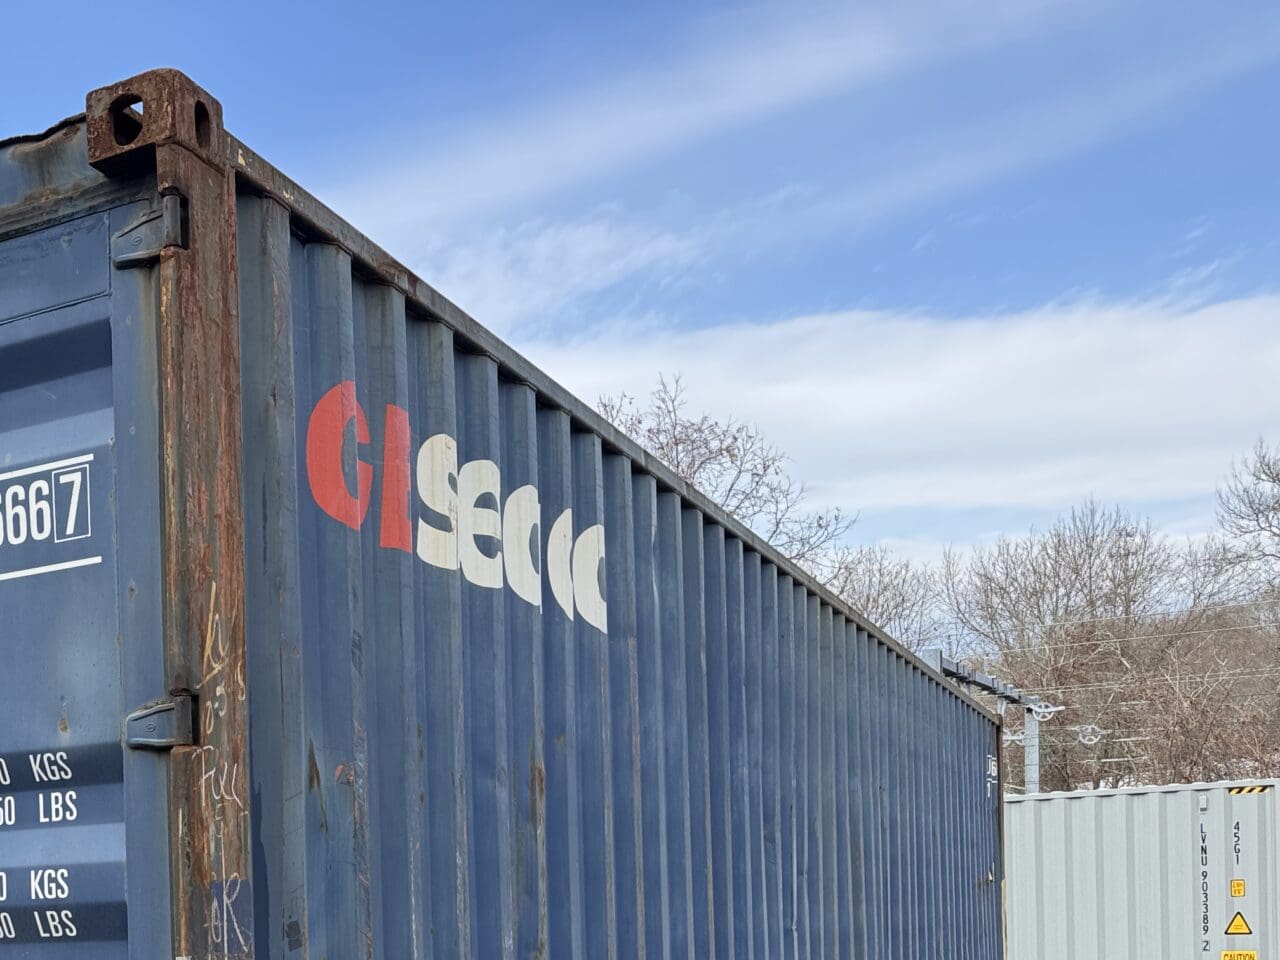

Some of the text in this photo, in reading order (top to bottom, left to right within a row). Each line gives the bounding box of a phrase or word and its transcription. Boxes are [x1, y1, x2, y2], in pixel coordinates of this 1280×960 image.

[29, 752, 72, 782] KGS
[38, 791, 78, 823] LBS
[30, 868, 69, 900] KGS
[34, 910, 77, 938] LBS
